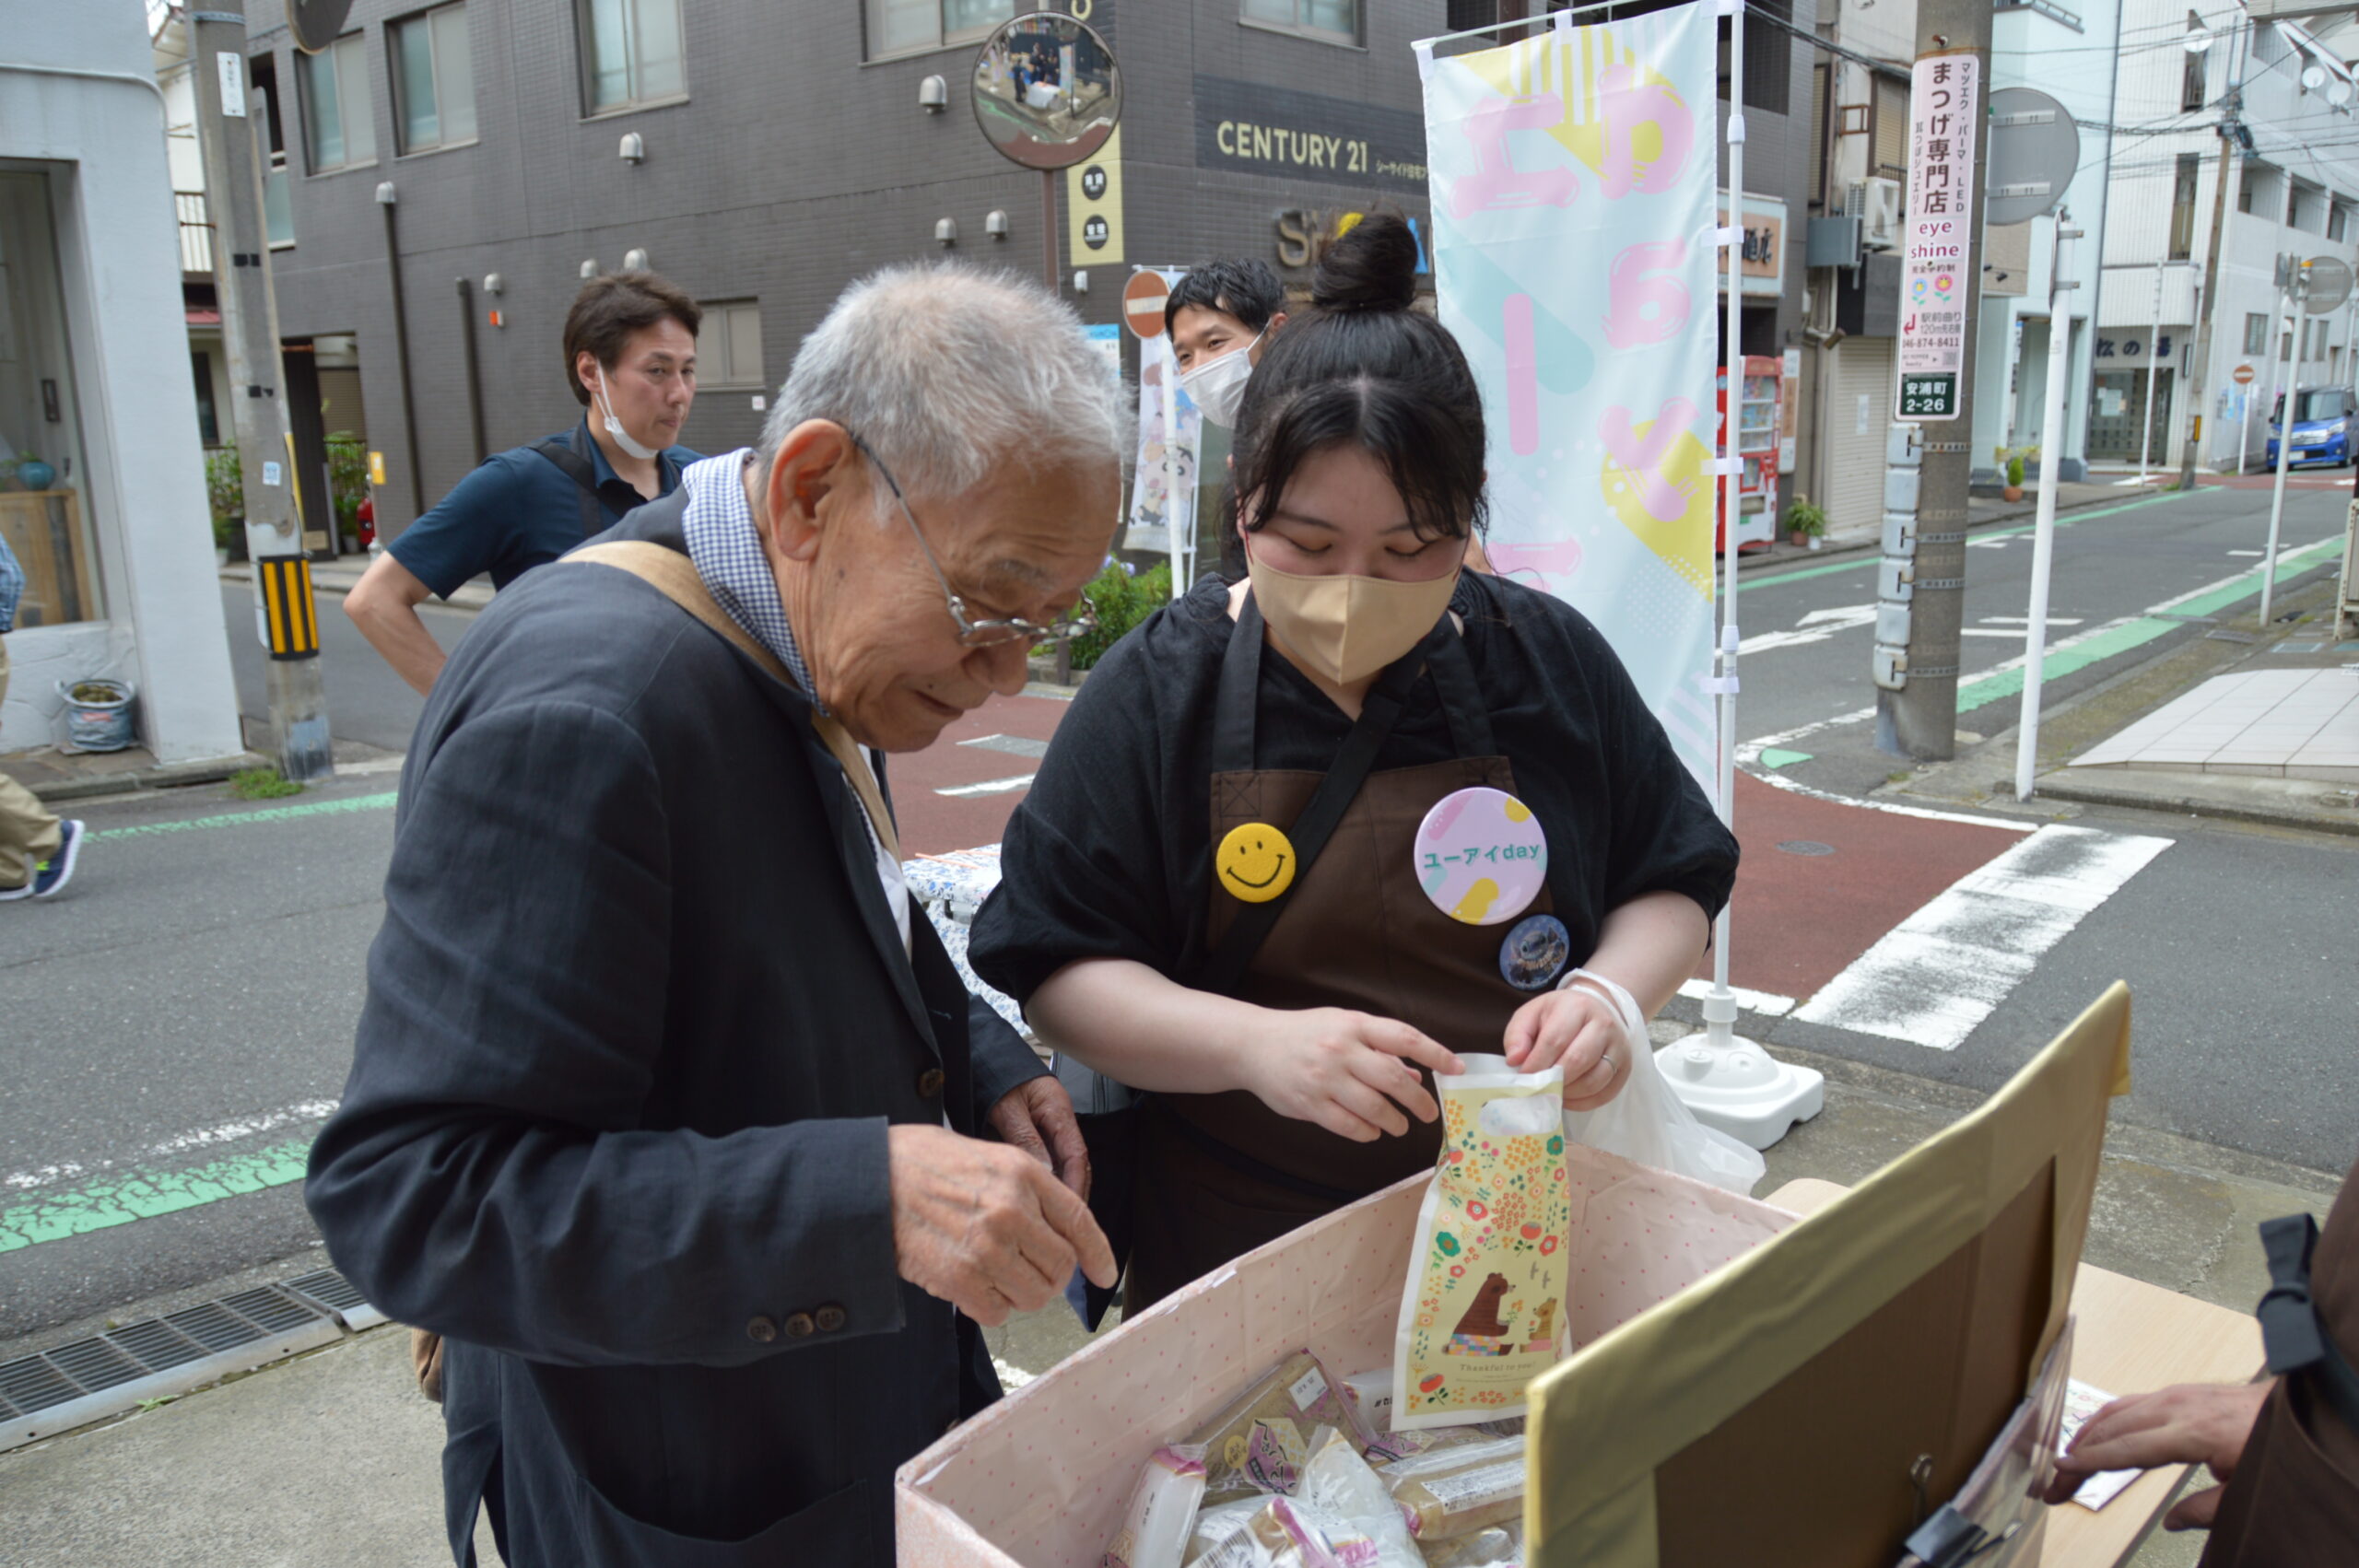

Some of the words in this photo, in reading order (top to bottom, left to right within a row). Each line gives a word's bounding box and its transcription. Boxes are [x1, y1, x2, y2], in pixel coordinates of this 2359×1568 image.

[1924, 62, 1954, 214] まつげ専門店
[1217, 121, 1341, 170] CENTURY
[1346, 141, 1367, 173] 21
[1919, 222, 1952, 238] eye
[1910, 241, 1960, 259] shine
[1906, 381, 1948, 395] 安浦町
[1906, 398, 1945, 412] 2-26
[1424, 843, 1542, 869] ユーアイday
[1460, 1363, 1504, 1372] Thankful
